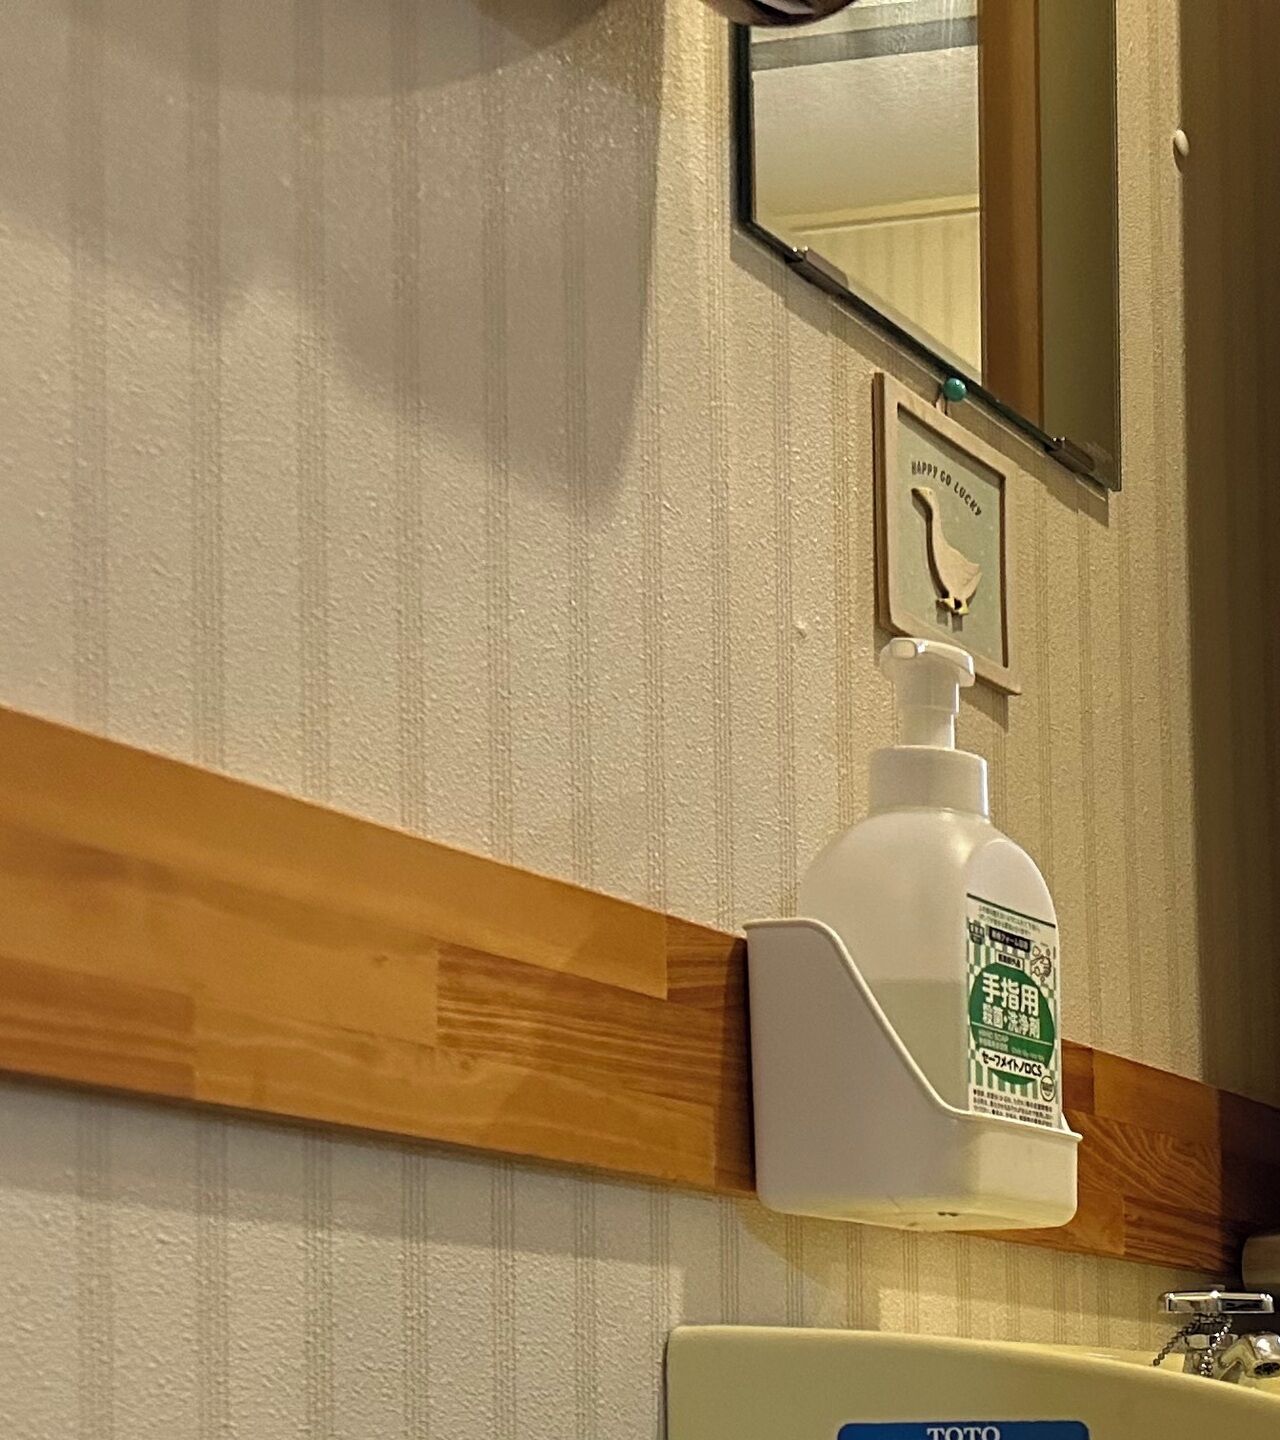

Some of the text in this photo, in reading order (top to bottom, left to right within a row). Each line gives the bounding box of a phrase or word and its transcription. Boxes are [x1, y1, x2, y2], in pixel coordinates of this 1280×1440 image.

[911, 460, 982, 516] HAPPY GO LUCKY
[981, 971, 1039, 1017] 手指用
